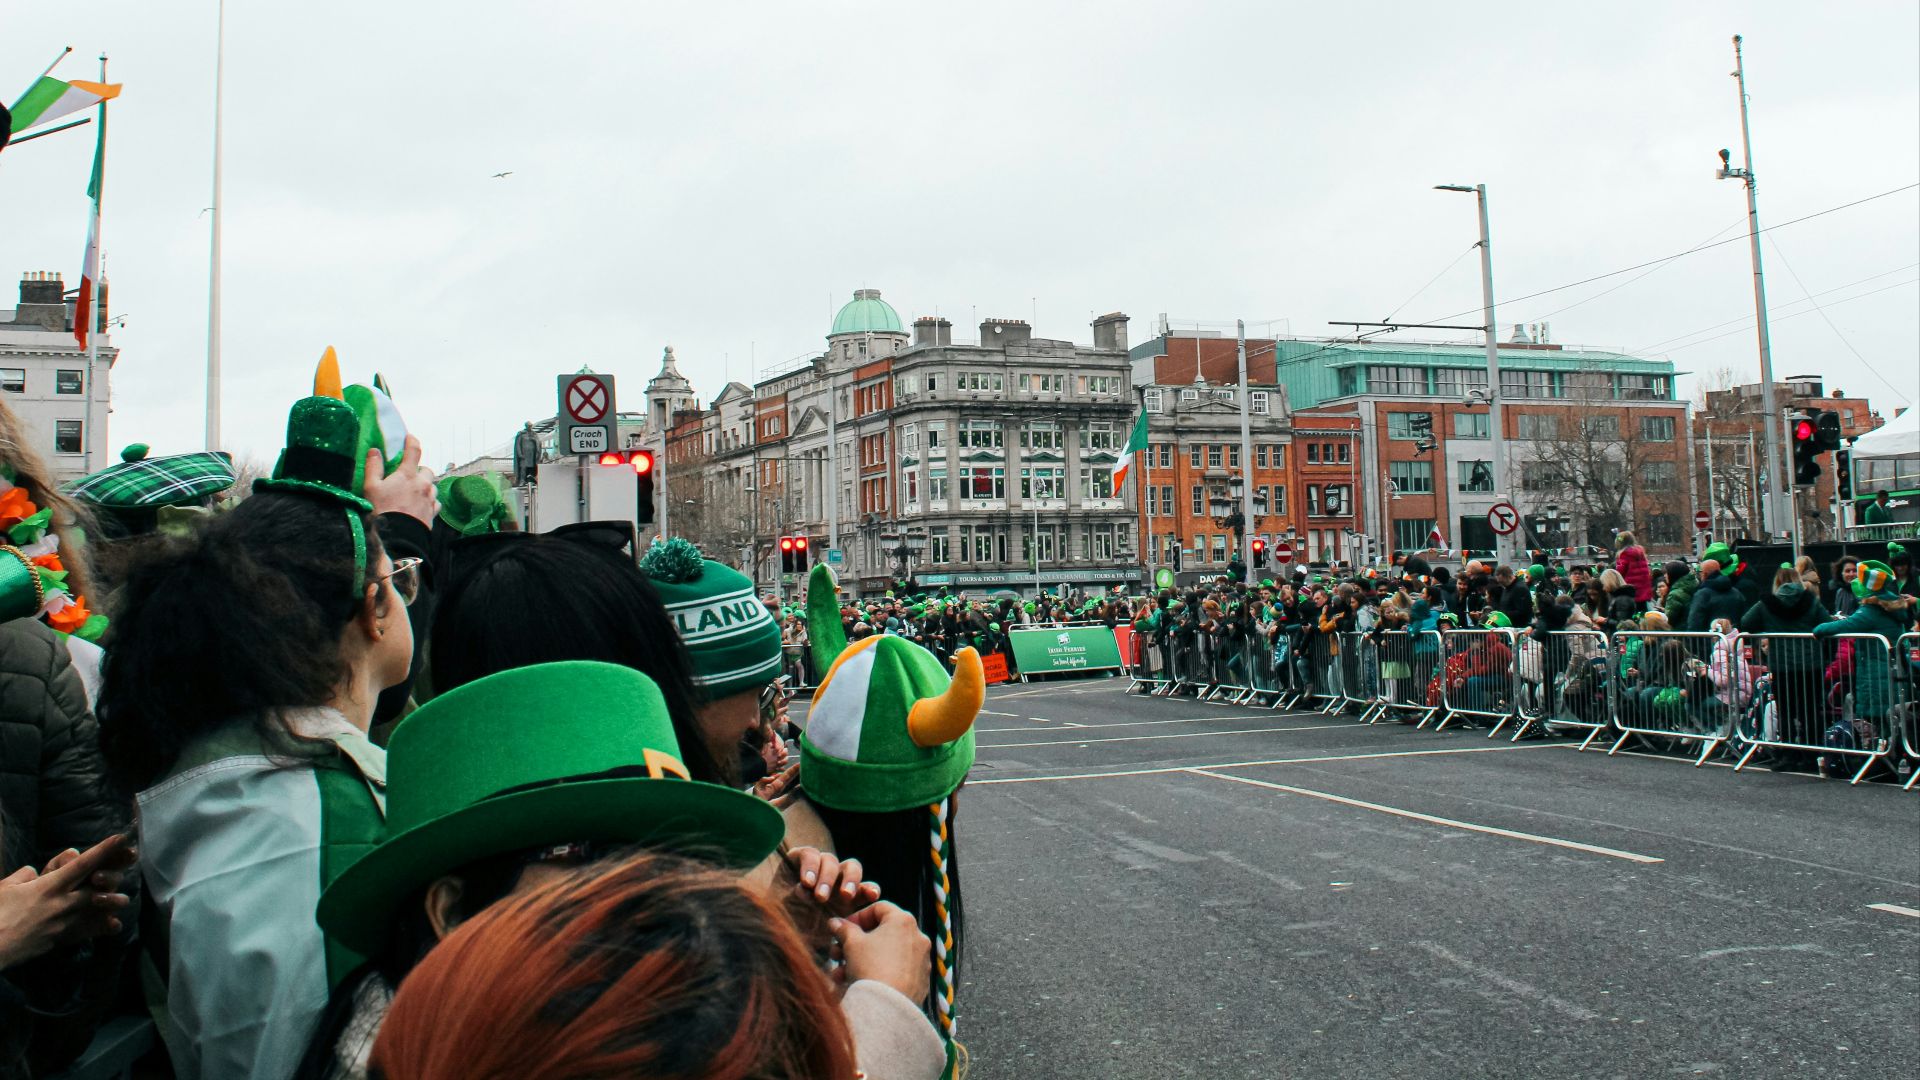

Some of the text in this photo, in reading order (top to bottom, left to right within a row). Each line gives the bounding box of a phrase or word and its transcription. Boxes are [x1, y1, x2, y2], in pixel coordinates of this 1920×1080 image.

[574, 430, 602, 438] Crioch
[579, 440, 599, 448] END
[672, 600, 759, 634] LAND
